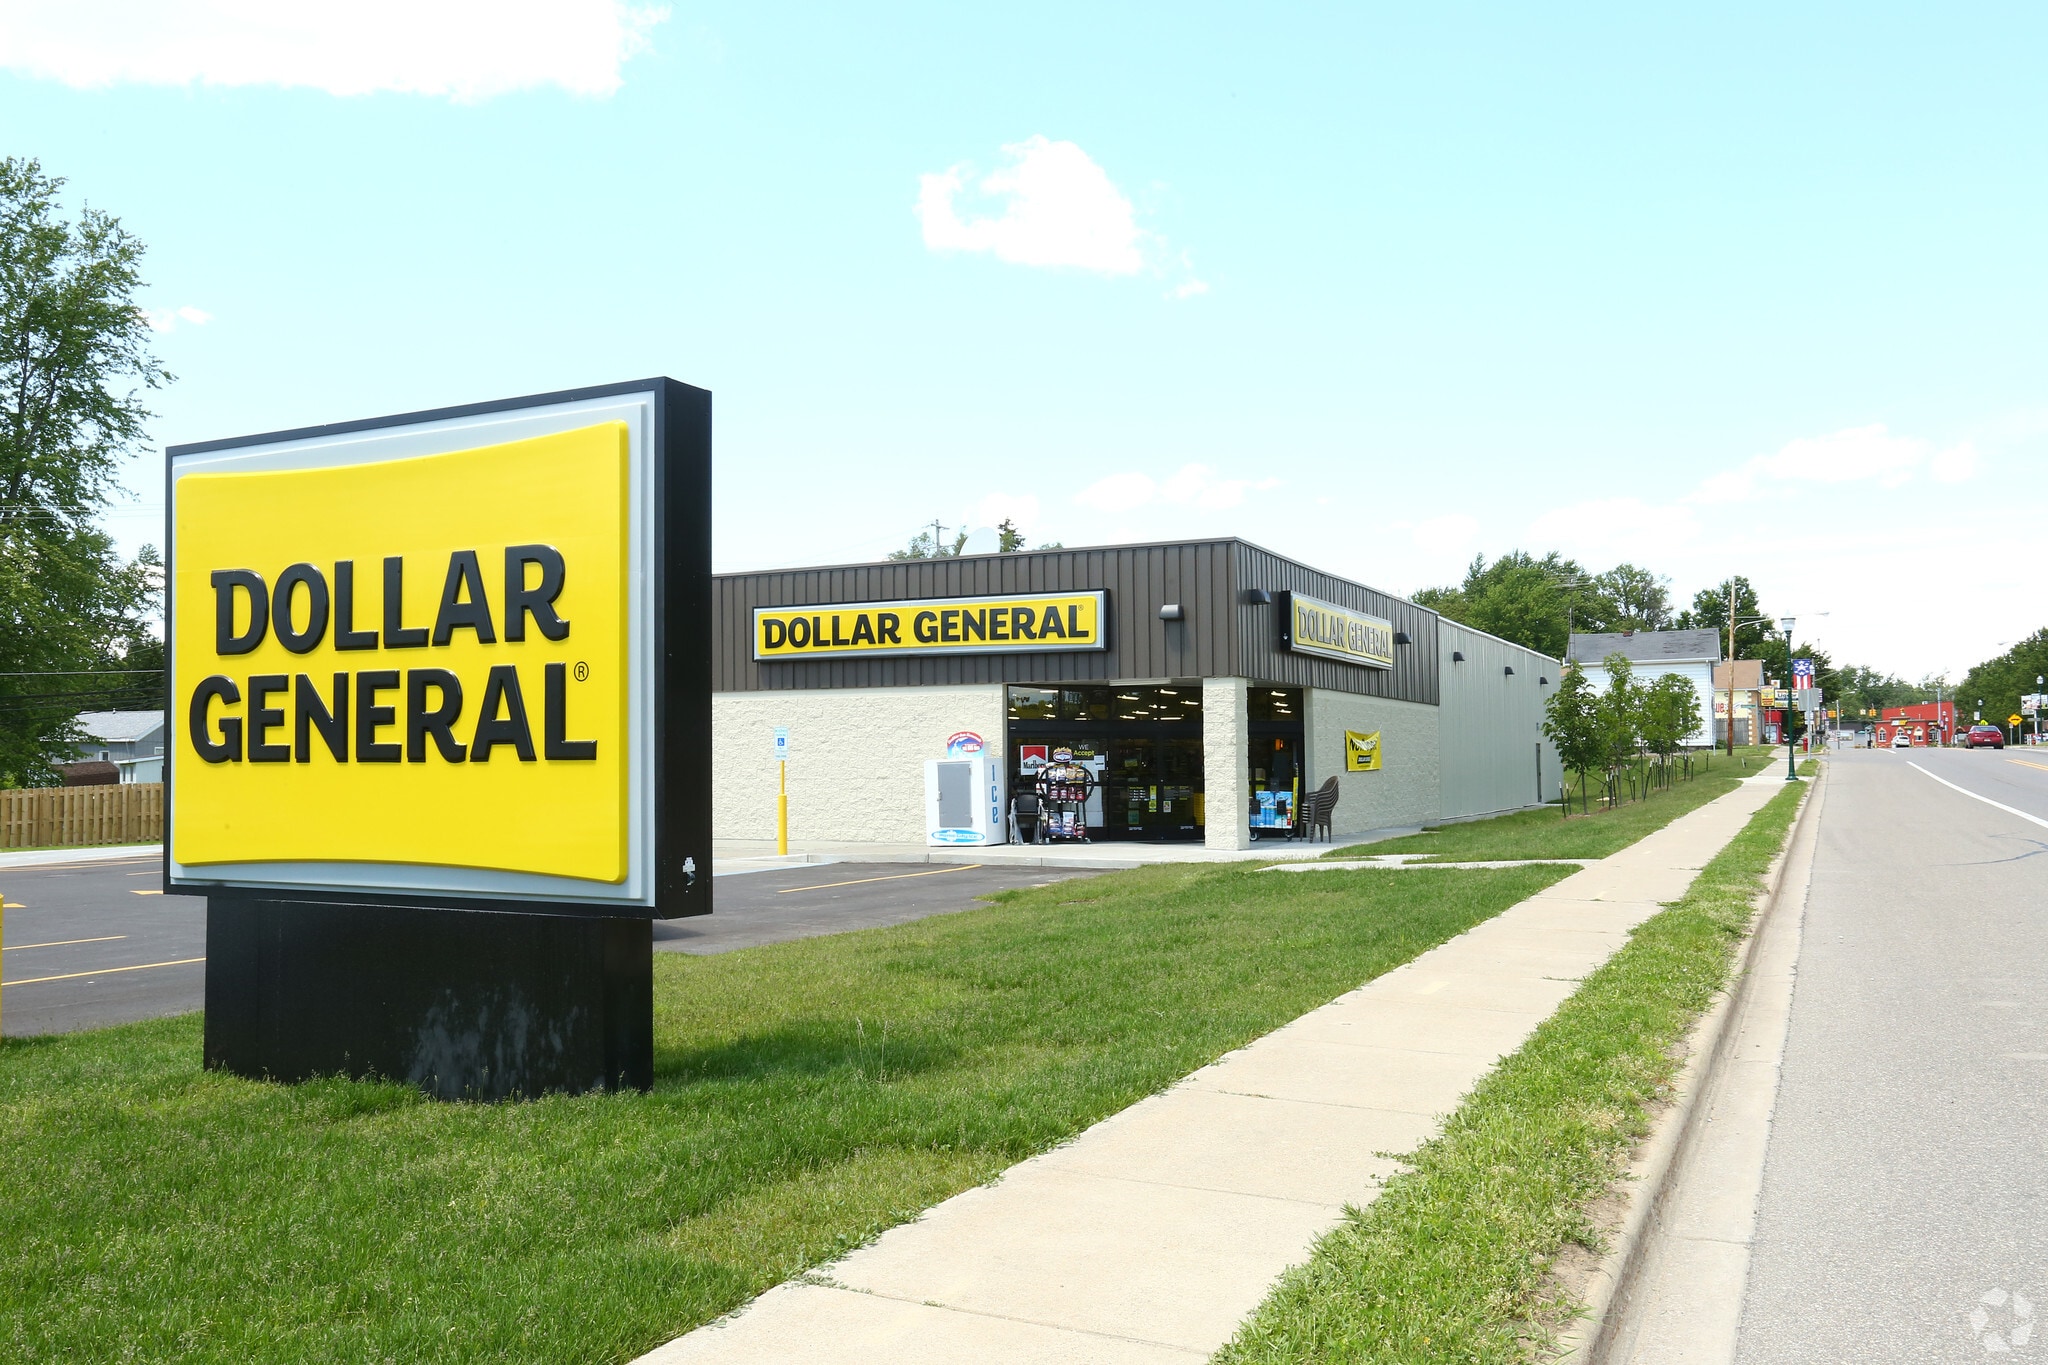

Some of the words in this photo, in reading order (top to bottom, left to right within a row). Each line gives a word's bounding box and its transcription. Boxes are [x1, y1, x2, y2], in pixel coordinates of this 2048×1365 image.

[210, 544, 570, 656] DOLLAR
[762, 613, 901, 649] DOLLAR
[1297, 606, 1345, 648] DOLLAR
[1347, 621, 1392, 659] GENERAL
